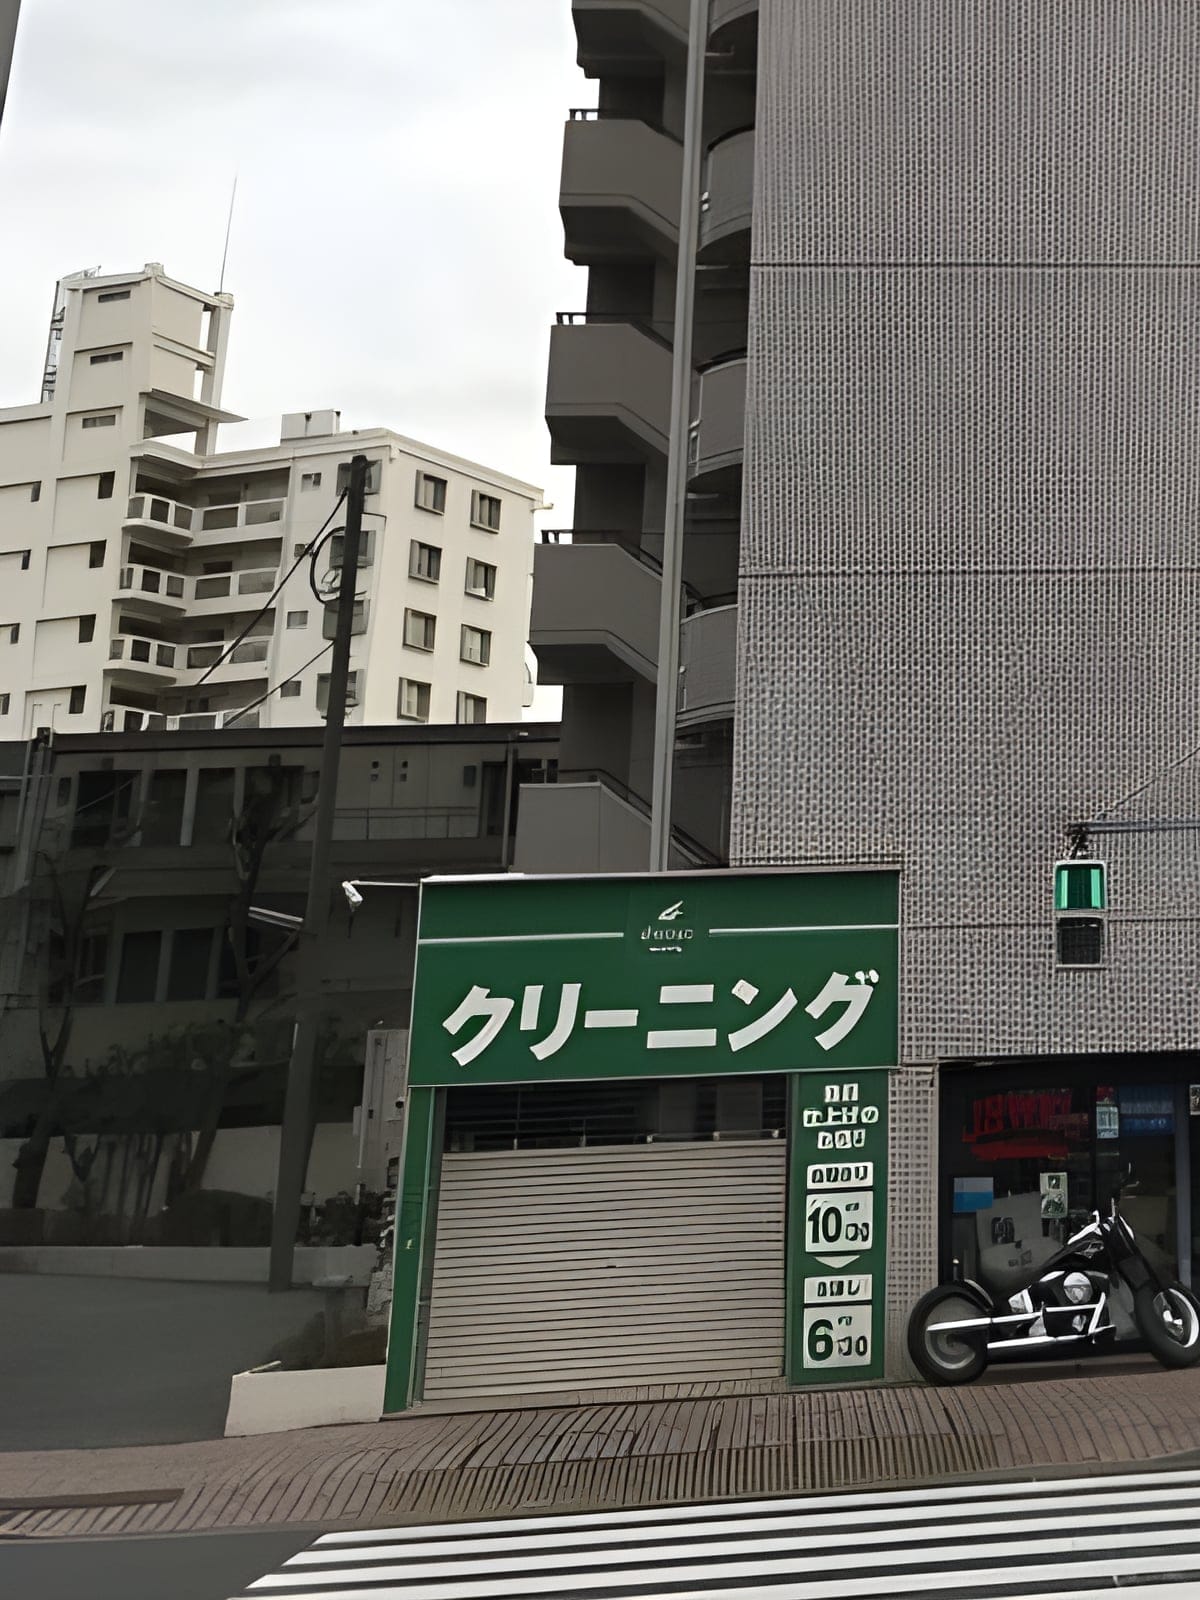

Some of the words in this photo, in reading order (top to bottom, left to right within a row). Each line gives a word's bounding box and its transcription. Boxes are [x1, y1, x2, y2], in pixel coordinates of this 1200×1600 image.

[442, 969, 880, 1067] クリーニング
